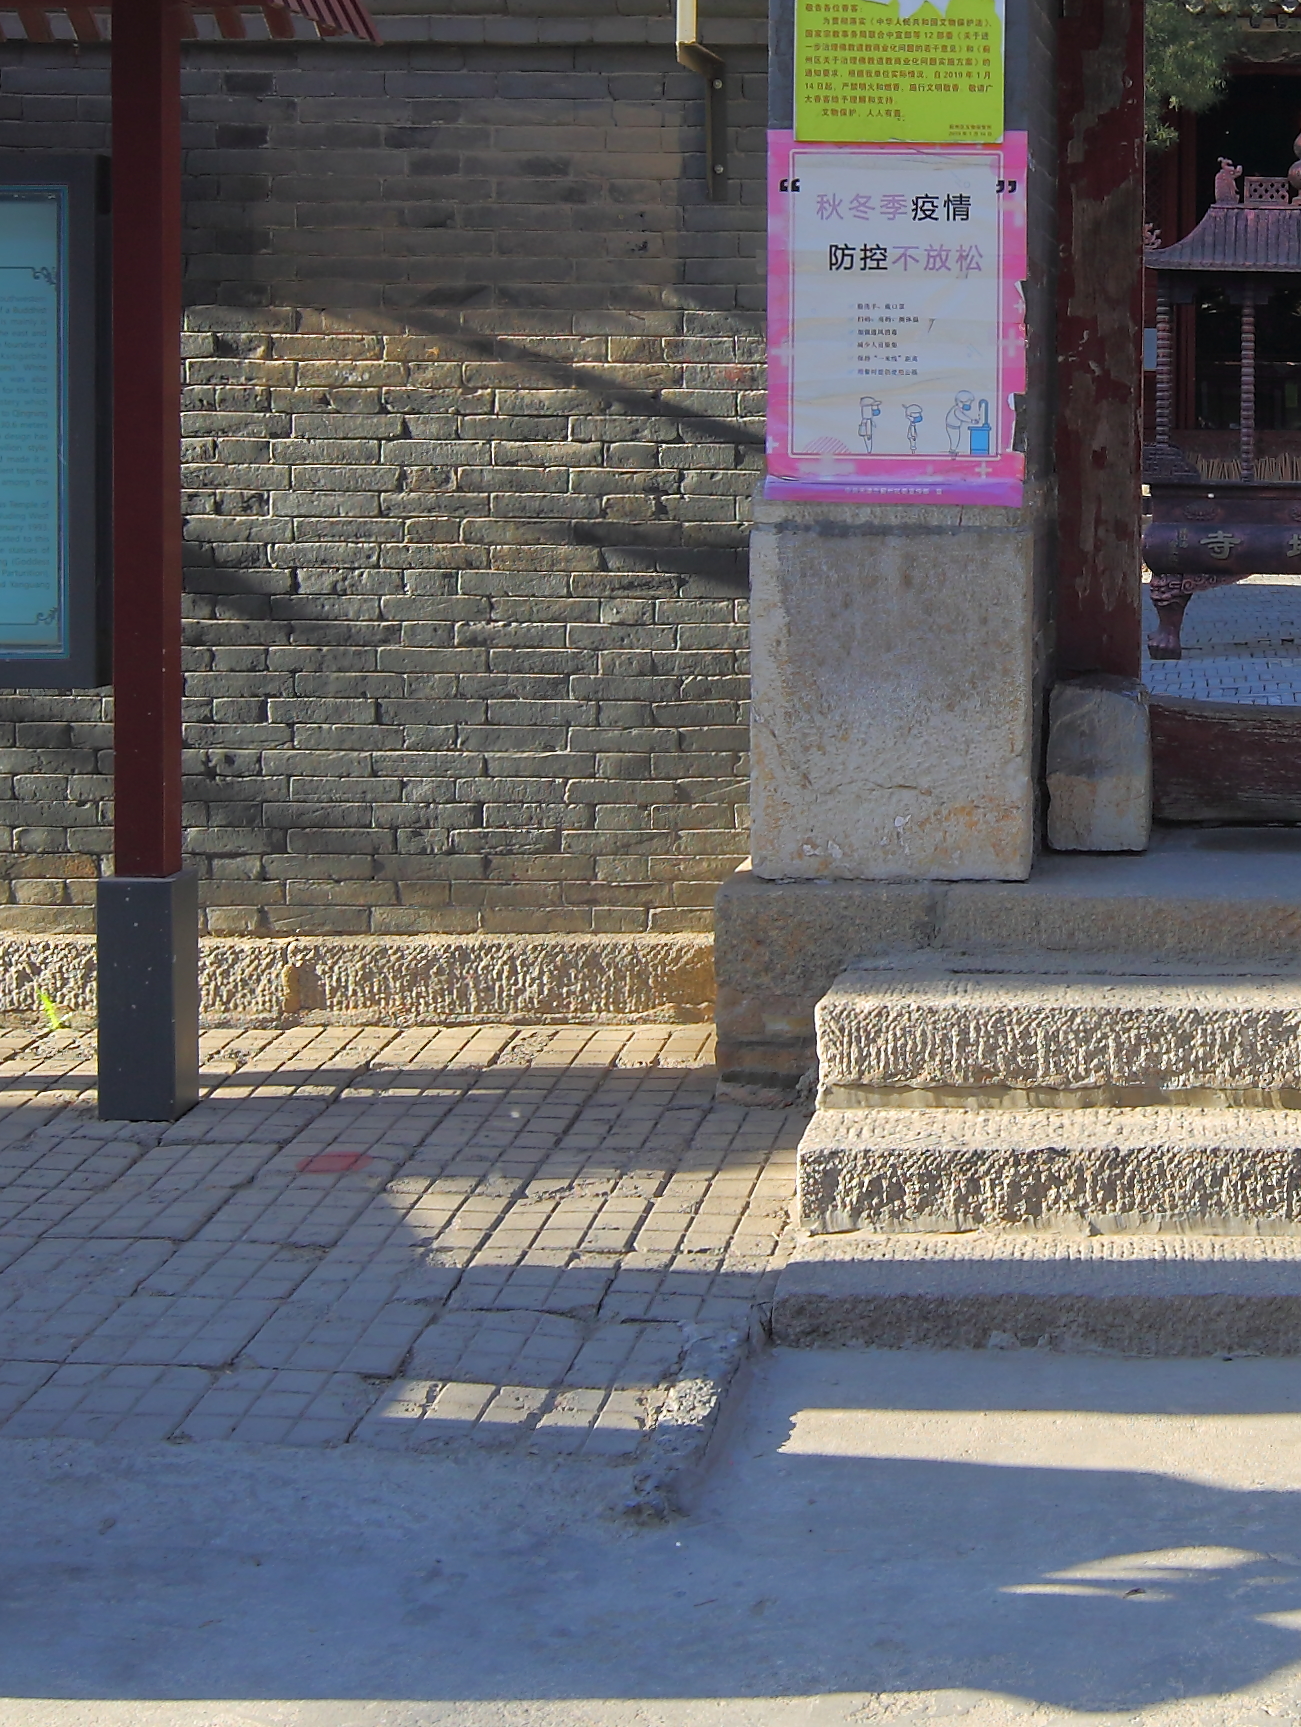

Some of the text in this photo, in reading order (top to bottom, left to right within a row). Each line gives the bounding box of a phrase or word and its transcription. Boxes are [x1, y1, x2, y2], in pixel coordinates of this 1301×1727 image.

[816, 193, 972, 222] 秋冬季疫情
[828, 243, 983, 272] 防控不放松
